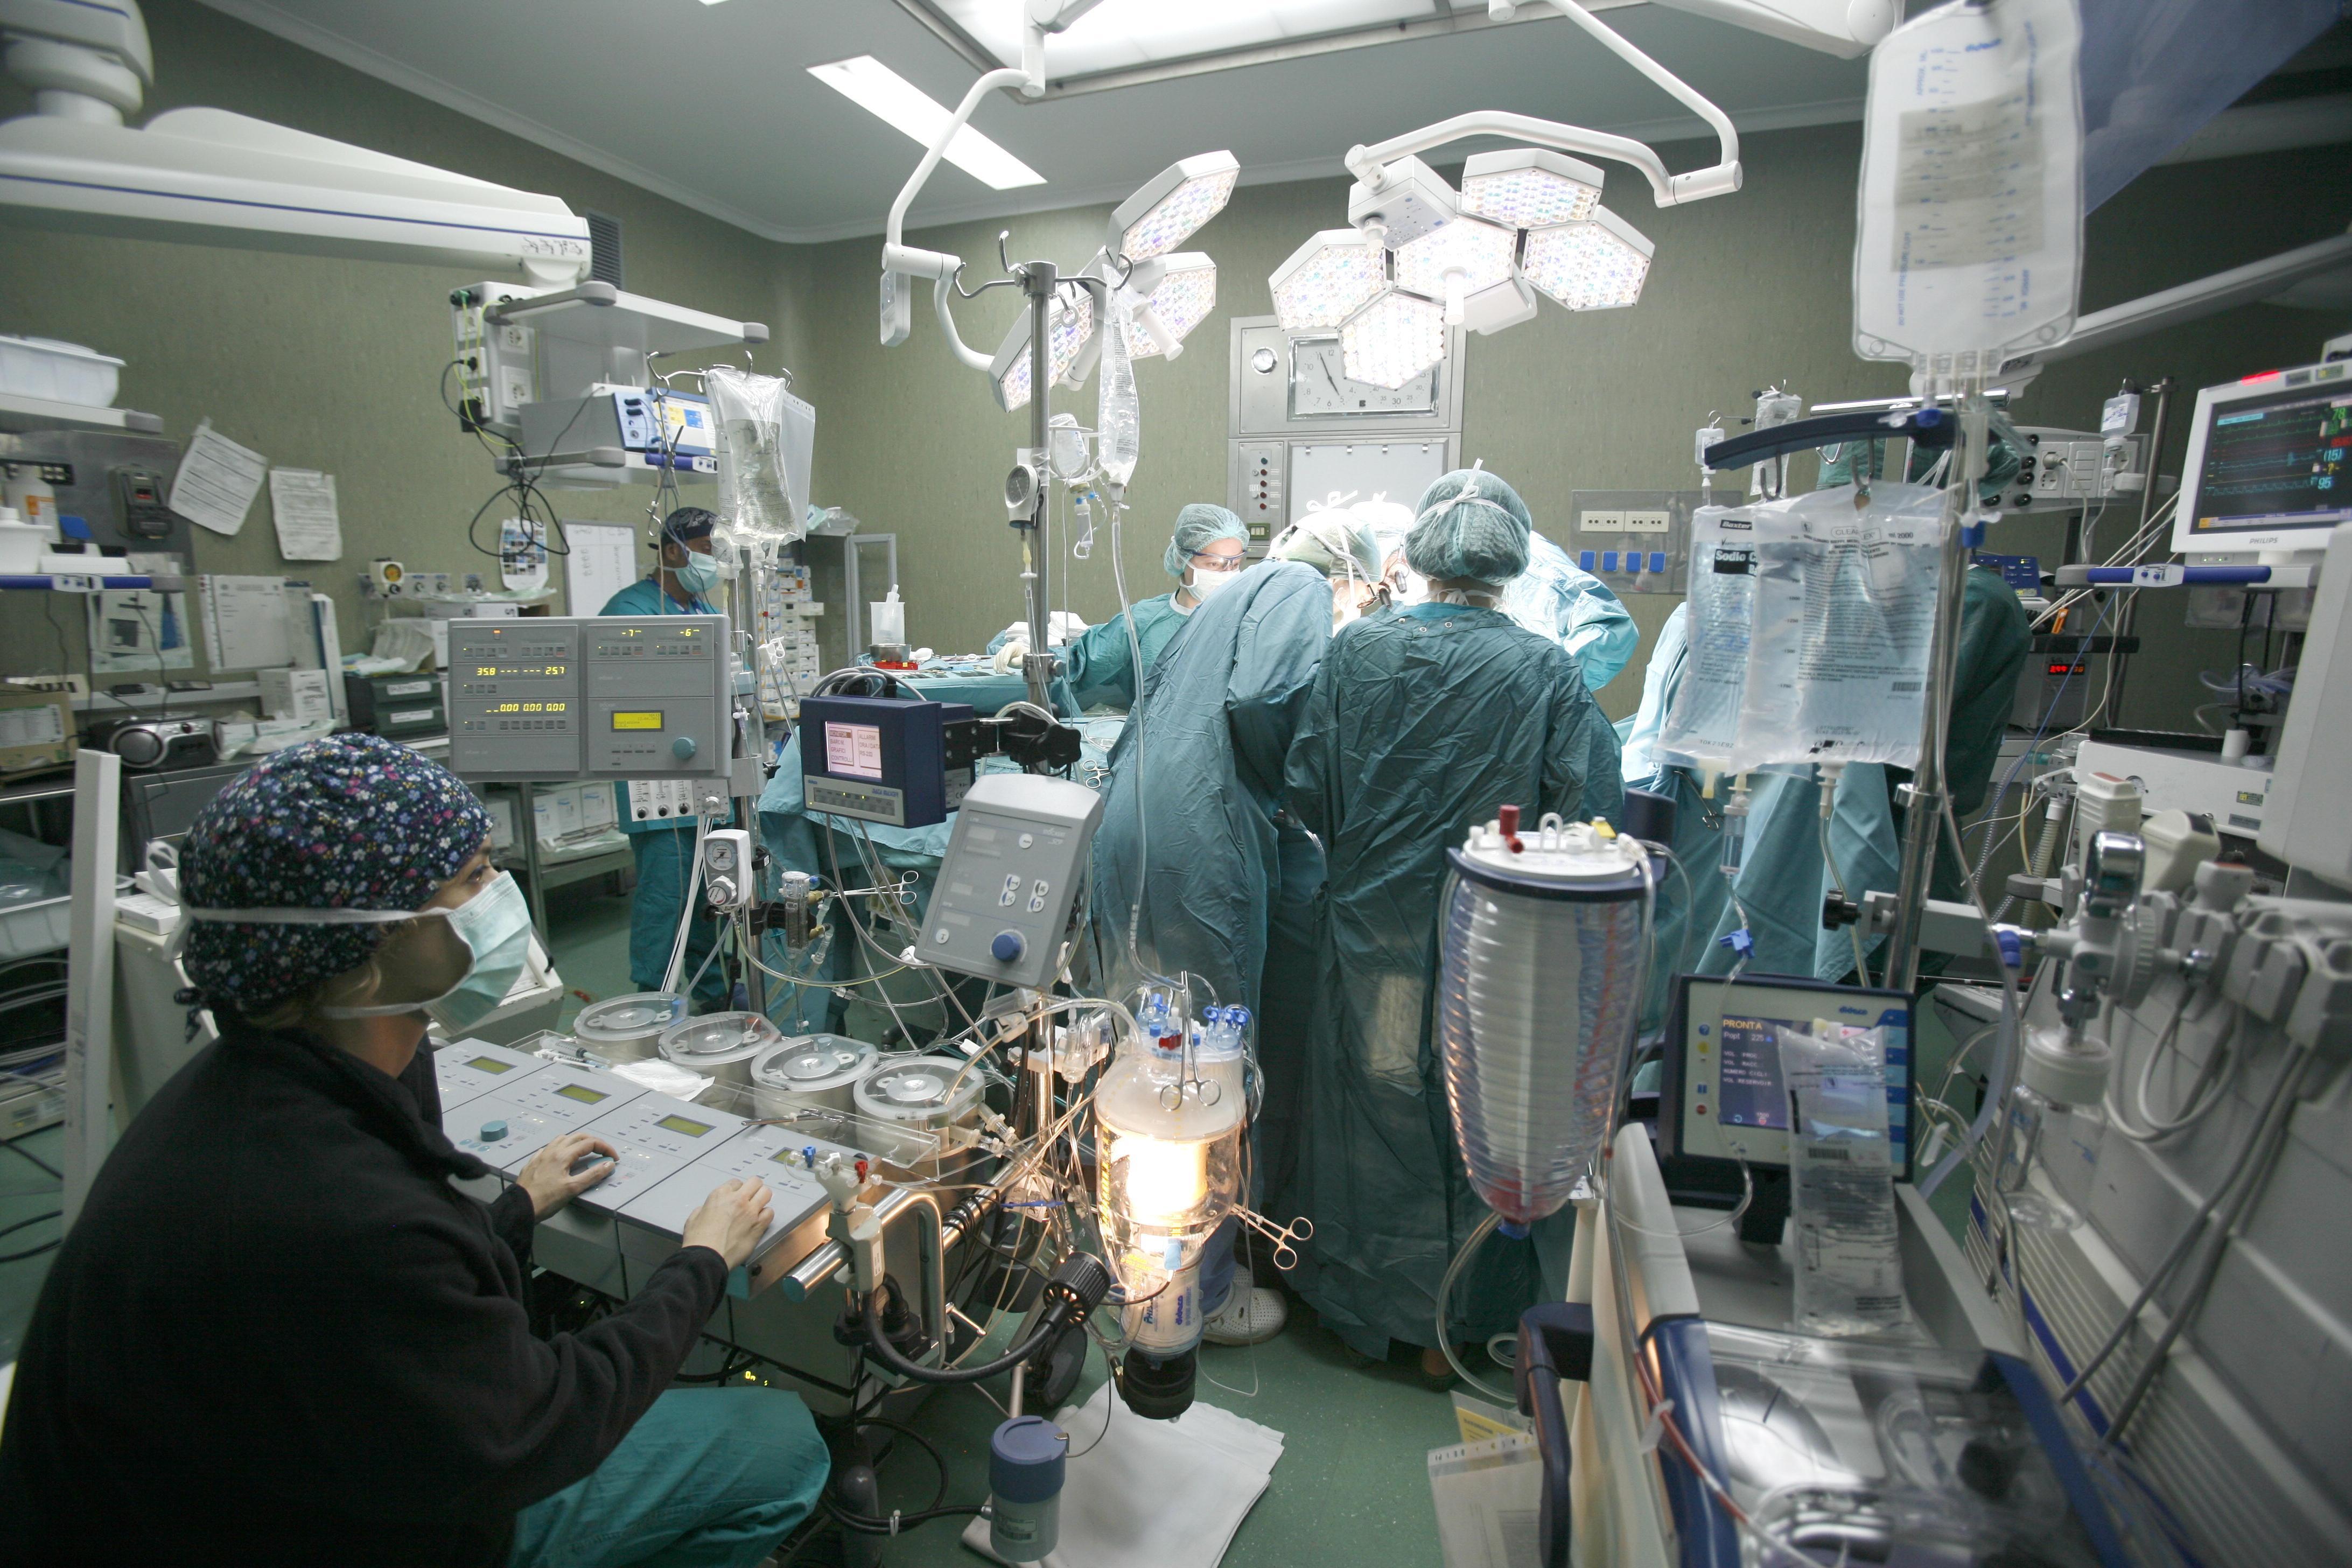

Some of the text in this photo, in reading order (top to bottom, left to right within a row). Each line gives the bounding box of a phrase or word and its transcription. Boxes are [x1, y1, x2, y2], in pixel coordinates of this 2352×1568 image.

[1899, 253, 1910, 286] PRESSURE
[2318, 477, 2332, 489] 95
[1722, 521, 1752, 530] Baxter
[1716, 550, 1746, 561] Sodio
[523, 703, 542, 711] 0.00
[546, 703, 565, 711] 0.00
[1723, 1019, 1762, 1031] PRONTA
